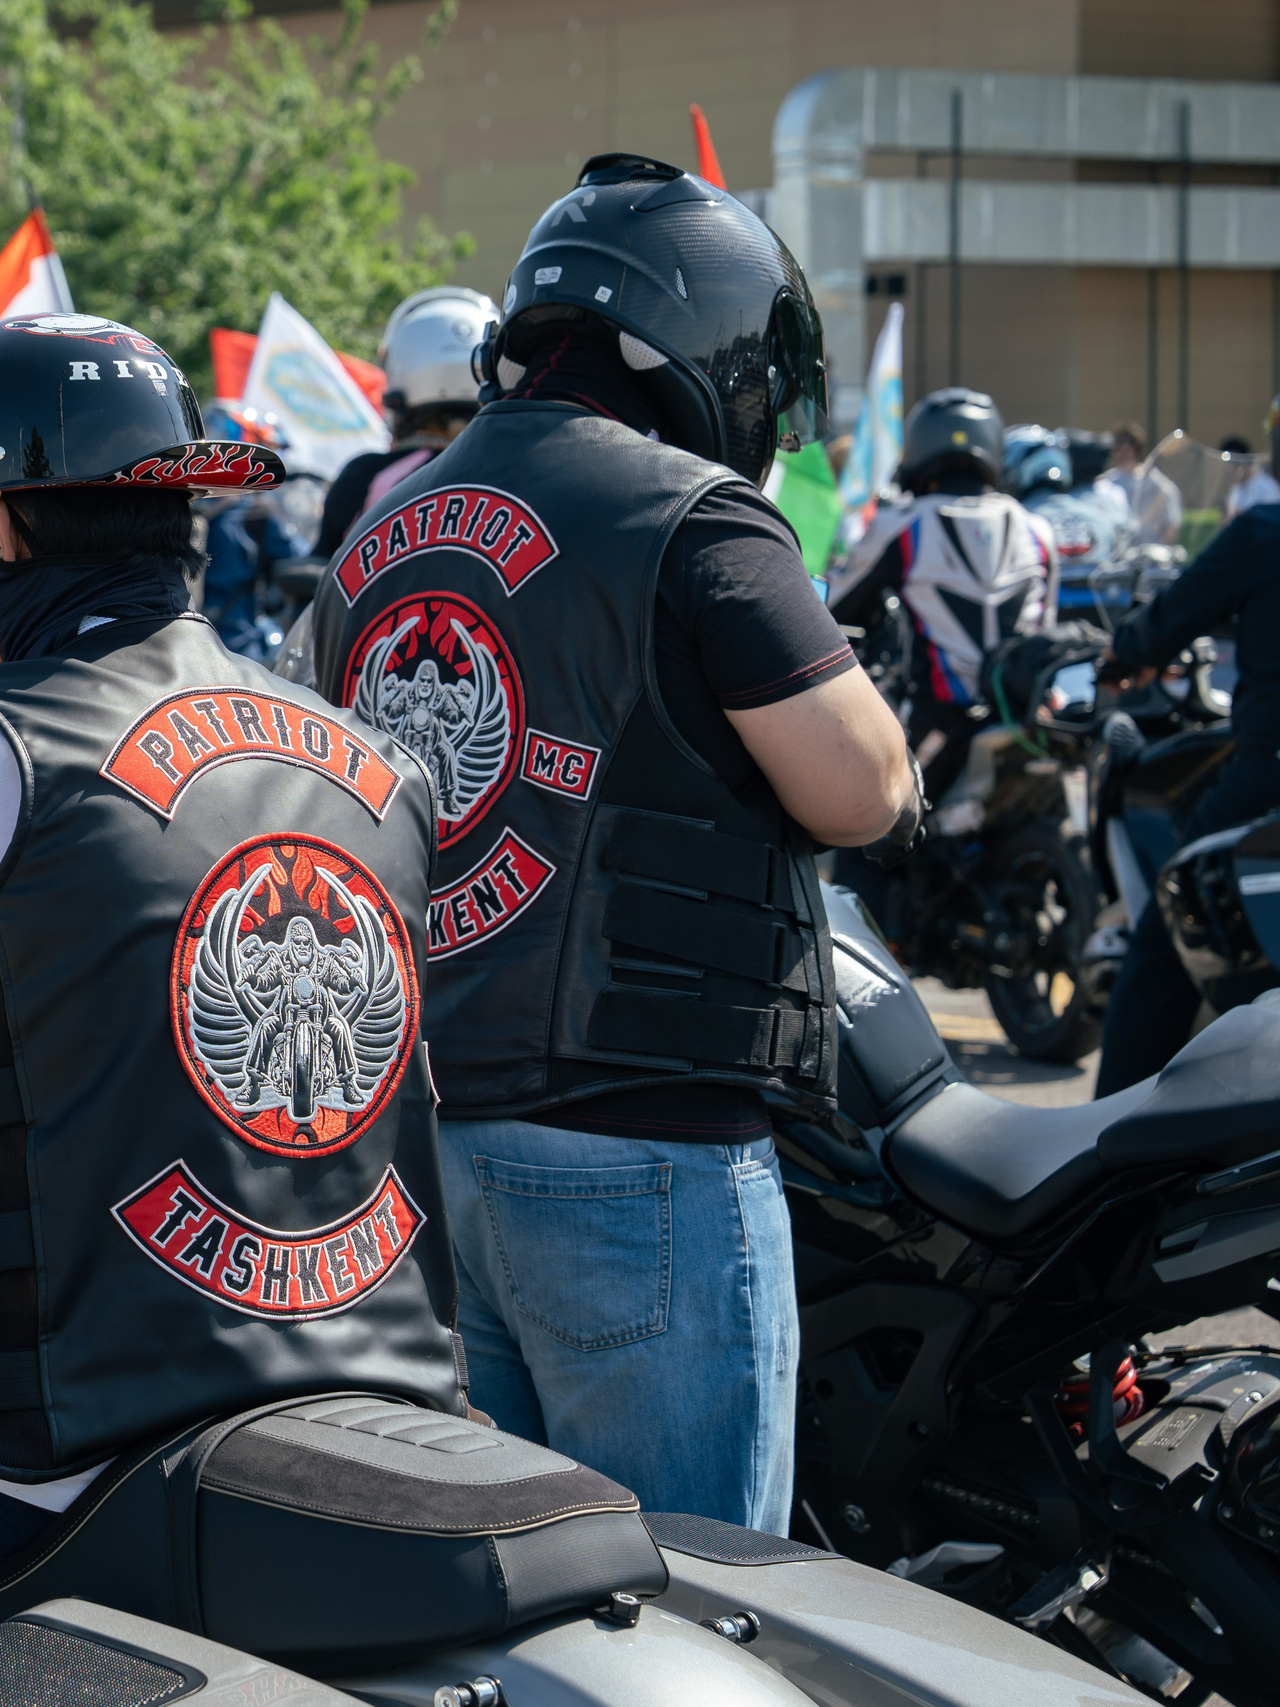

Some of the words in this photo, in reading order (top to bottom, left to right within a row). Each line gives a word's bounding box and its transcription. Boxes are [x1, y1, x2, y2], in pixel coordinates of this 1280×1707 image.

[358, 494, 536, 581] PATRIOT
[136, 696, 371, 787] PATRIOT
[531, 740, 586, 788] MC
[150, 1185, 404, 1306] TASHKENT
